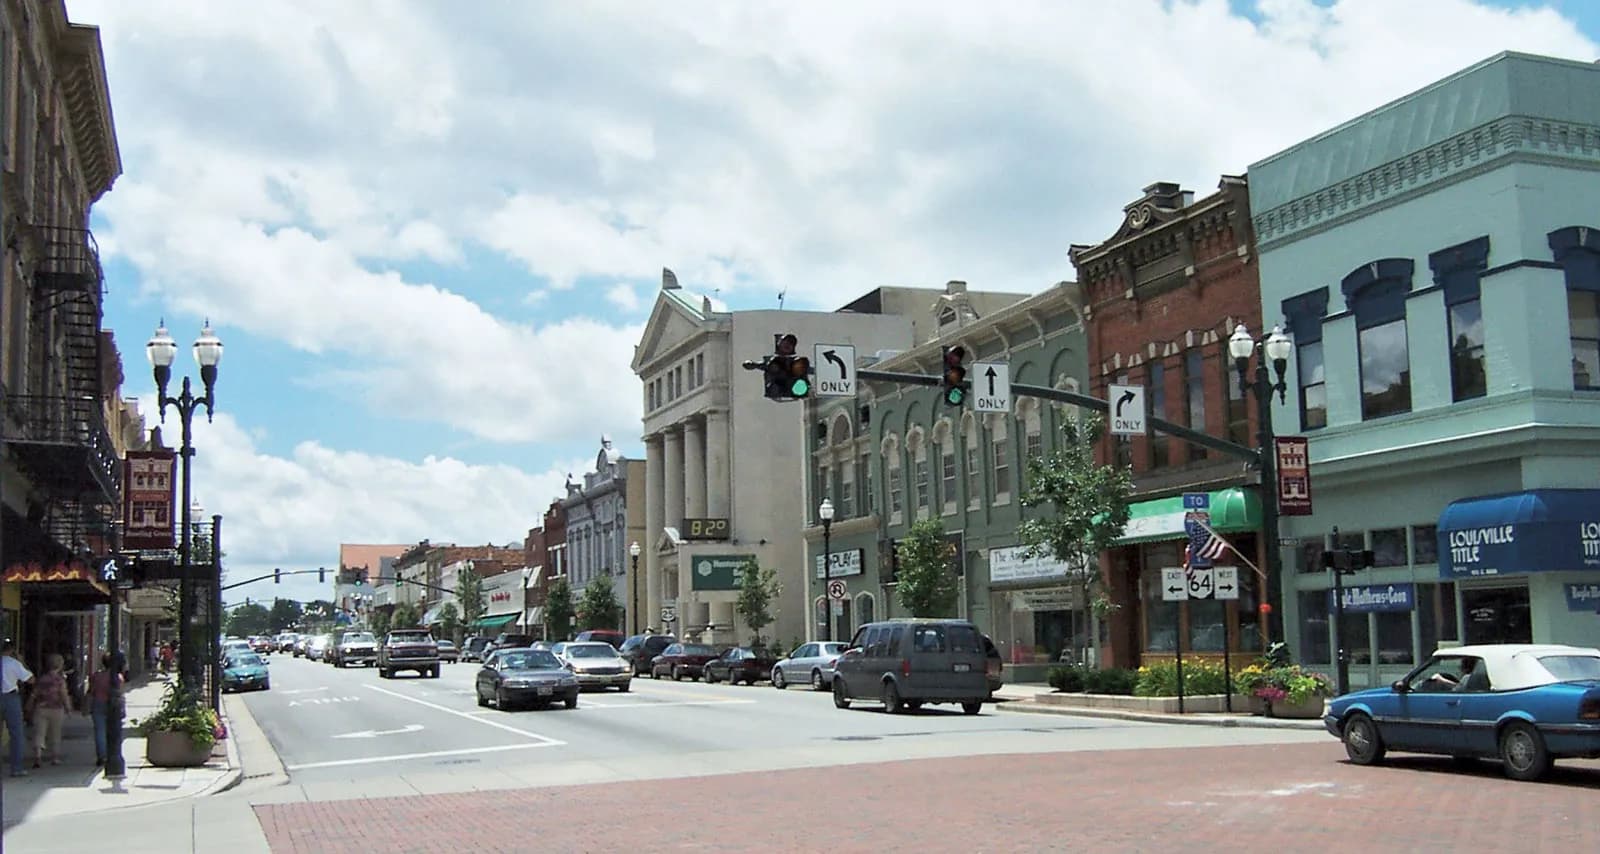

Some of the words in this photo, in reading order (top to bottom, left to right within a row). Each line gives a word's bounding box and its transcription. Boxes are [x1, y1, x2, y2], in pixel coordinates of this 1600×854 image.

[821, 381, 850, 392] ONLY
[978, 398, 1006, 408] ONLY
[1115, 419, 1141, 430] ONLY
[1189, 496, 1203, 505] TO
[1450, 525, 1514, 547] LOUISVILLE
[1581, 522, 1600, 539] LO
[994, 551, 1006, 563] The
[1451, 546, 1480, 563] TITLE
[1167, 571, 1182, 580] EAST
[1219, 570, 1233, 579] WEST
[1190, 574, 1210, 591] 64
